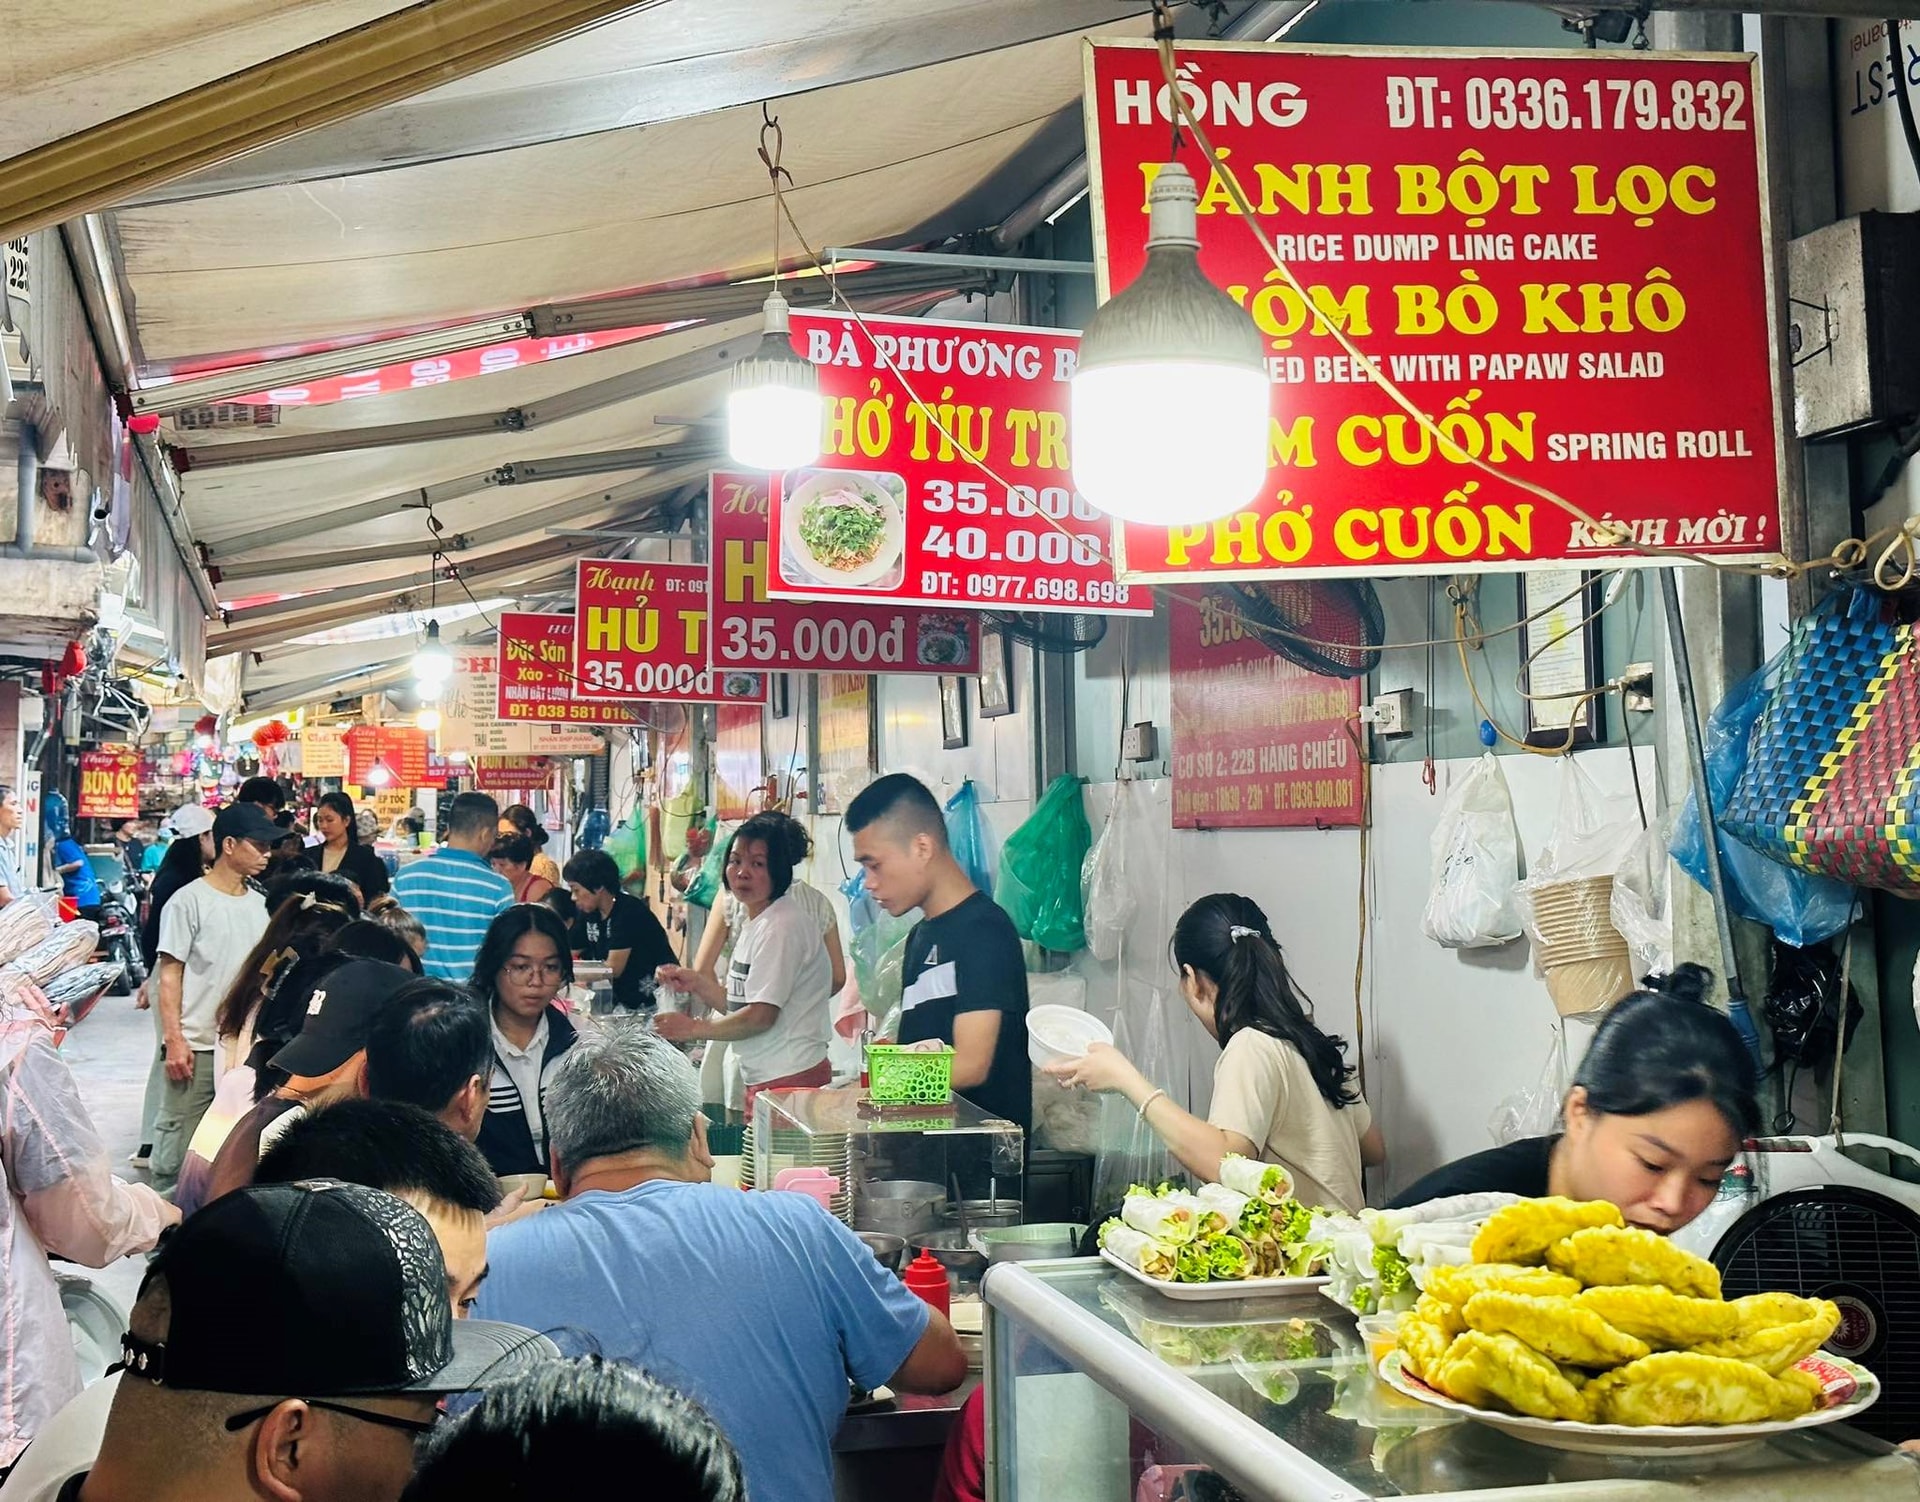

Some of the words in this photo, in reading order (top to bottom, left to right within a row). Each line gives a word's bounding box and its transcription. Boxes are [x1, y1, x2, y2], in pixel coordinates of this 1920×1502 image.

[1113, 62, 1308, 128] HỒNG
[1386, 76, 1453, 129] ĐT:
[1465, 76, 1747, 131] 0336.179.832
[1138, 146, 1374, 216] ÁNH
[1394, 147, 1550, 228] BỘT
[1570, 164, 1717, 228] LỌC
[1275, 233, 1345, 262] RICE
[1353, 233, 1440, 262] DUMP
[1448, 233, 1515, 261] LING
[1523, 233, 1599, 261] CAKE
[1392, 268, 1499, 336] BÒ
[1519, 266, 1687, 334] KHÔ
[806, 321, 863, 369] BÀ
[872, 334, 1043, 381] PHƯƠNG
[1052, 347, 1080, 382] B
[1313, 355, 1382, 384] BEEF
[1389, 353, 1461, 382] WITH
[1468, 352, 1570, 381] PAPAW
[1578, 351, 1665, 380] SALAD
[822, 376, 894, 458] HỞ
[905, 385, 993, 464] TÍU
[1005, 407, 1072, 470] TR
[1336, 388, 1537, 467] CUỐN
[1547, 431, 1667, 462] SPRING
[1676, 429, 1753, 458] ROLL
[920, 524, 1112, 567] 40.000
[1164, 489, 1313, 566] PHỞ
[1333, 480, 1535, 561] CUỐN
[1674, 508, 1748, 545] MỜI
[585, 566, 655, 596] Hạnh
[665, 578, 685, 593] ĐT:
[688, 578, 708, 593] 091
[920, 570, 959, 596] ĐT:
[966, 572, 1130, 605] 0977.698.698
[586, 594, 660, 654] HỦ
[677, 609, 707, 655] T
[720, 615, 906, 664] 35.000đ
[1200, 596, 1253, 648] 35.0
[537, 704, 566, 718] 038
[569, 705, 597, 719] 581
[1259, 740, 1298, 773] HÀNG
[1302, 729, 1348, 770] CHIẾU
[82, 766, 114, 796] BÚN
[116, 765, 137, 796] ỐC
